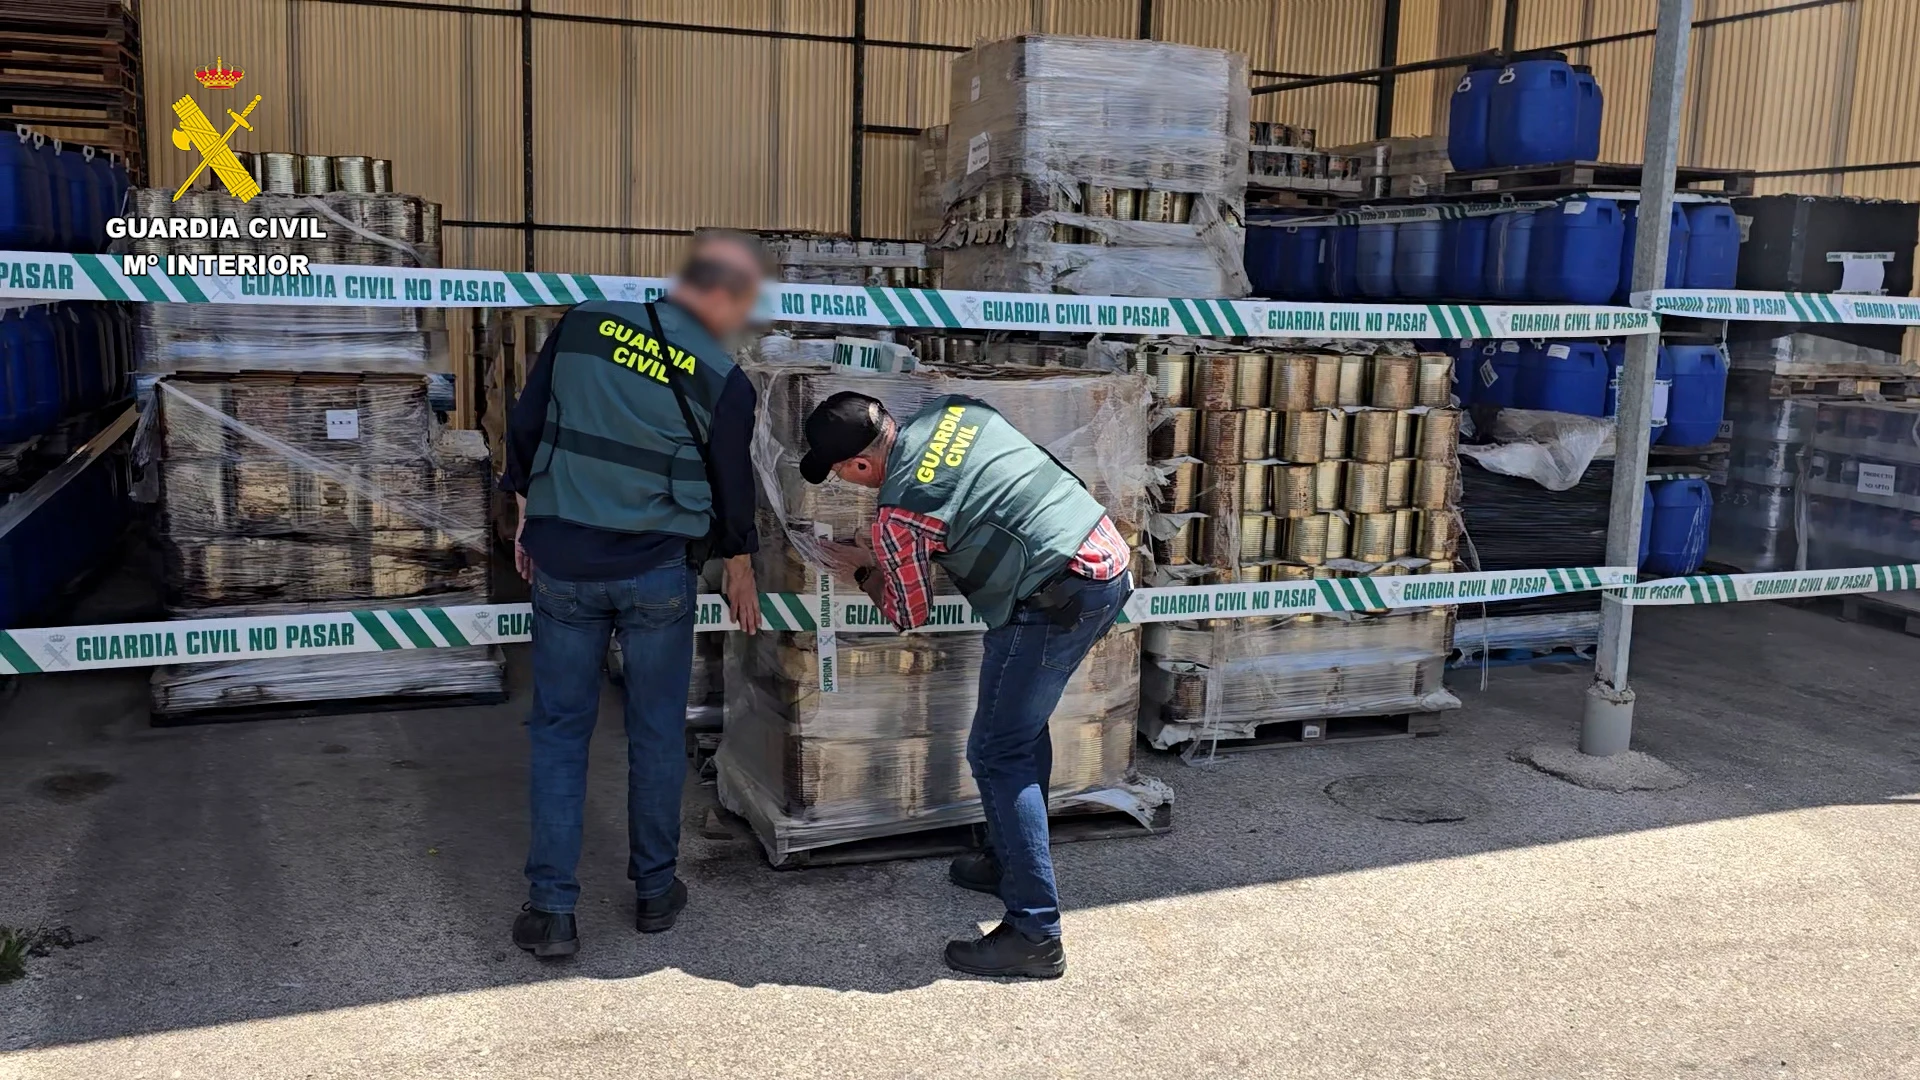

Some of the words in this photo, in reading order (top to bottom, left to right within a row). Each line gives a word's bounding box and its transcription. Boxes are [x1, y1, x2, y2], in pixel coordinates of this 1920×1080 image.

[0, 262, 74, 290] PASAR
[242, 272, 337, 299] GUARDIA
[345, 275, 397, 300] CIVIL
[405, 278, 432, 301] NO
[440, 279, 506, 303] PASAR
[781, 293, 804, 315] NO
[811, 294, 867, 317] PASAR
[983, 300, 1050, 324] GUARDIA
[1056, 303, 1092, 325] CIVIL
[1098, 305, 1117, 326] NO
[1123, 306, 1170, 327] PASAR
[1706, 297, 1732, 313] CIVIL
[1736, 298, 1750, 314] NO
[1751, 298, 1787, 315] PASAR
[1854, 301, 1896, 319] GUARDIA
[1268, 310, 1325, 331] GUARDIA
[1330, 311, 1361, 331] CIVIL
[1366, 312, 1382, 332] NO
[1387, 312, 1428, 332] PASAR
[1511, 313, 1560, 332] GUARDIA
[1564, 313, 1591, 331] CIVIL
[1595, 313, 1610, 330] NO
[1613, 312, 1649, 329] PASAR
[613, 347, 670, 384] CIVIL
[916, 405, 966, 484] GUARDIA
[944, 424, 979, 468] CIVIL
[1404, 581, 1454, 601] GUARDIA
[1459, 579, 1486, 598] CIVIL
[1490, 578, 1505, 596] NO
[1510, 576, 1546, 594] PASAR
[1650, 585, 1686, 600] PASAR
[1754, 578, 1796, 596] GUARDIA
[1798, 578, 1824, 593] CIVIL
[1824, 576, 1840, 591] NO
[1840, 574, 1873, 590] PASAR
[821, 593, 831, 628] GUARDIA
[1150, 594, 1209, 616] GUARDIA
[1215, 592, 1247, 613] CIVIL
[1252, 591, 1270, 610] NO
[1274, 588, 1316, 609] PASAR
[76, 632, 178, 662] GUARDIA
[186, 628, 241, 655] CIVIL
[249, 627, 277, 651] NO
[286, 623, 354, 648] PASAR
[823, 656, 833, 692] SEPRONA
